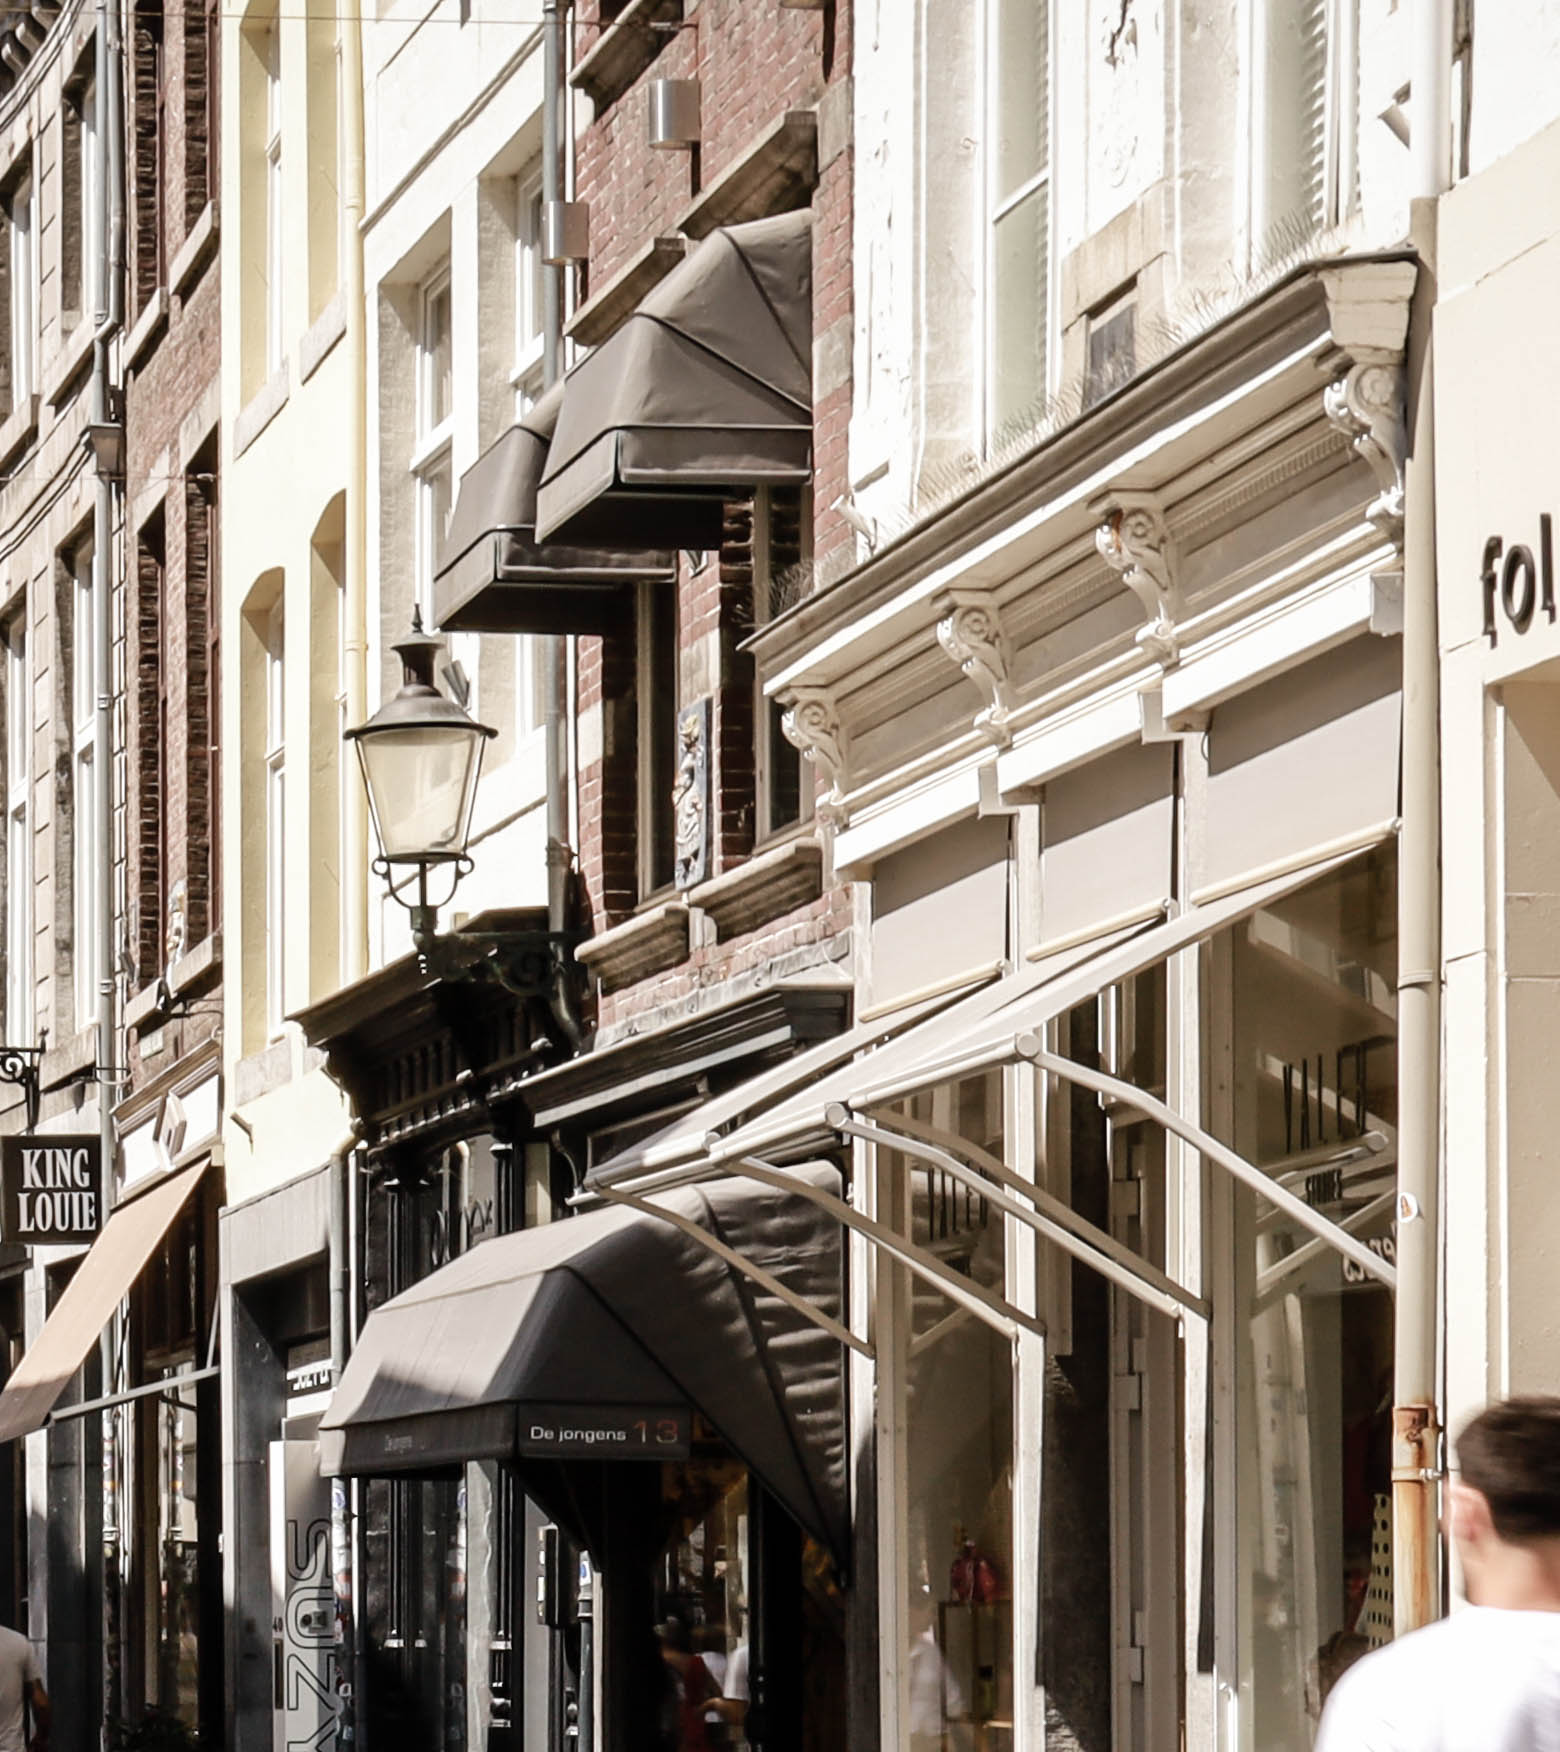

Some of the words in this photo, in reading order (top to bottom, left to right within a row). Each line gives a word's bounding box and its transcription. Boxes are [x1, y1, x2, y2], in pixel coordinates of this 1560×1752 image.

[21, 1148, 90, 1189] KING
[17, 1191, 97, 1232] LOUIE
[530, 1426, 554, 1440] De
[558, 1426, 627, 1443] jongens
[634, 1419, 679, 1444] 13
